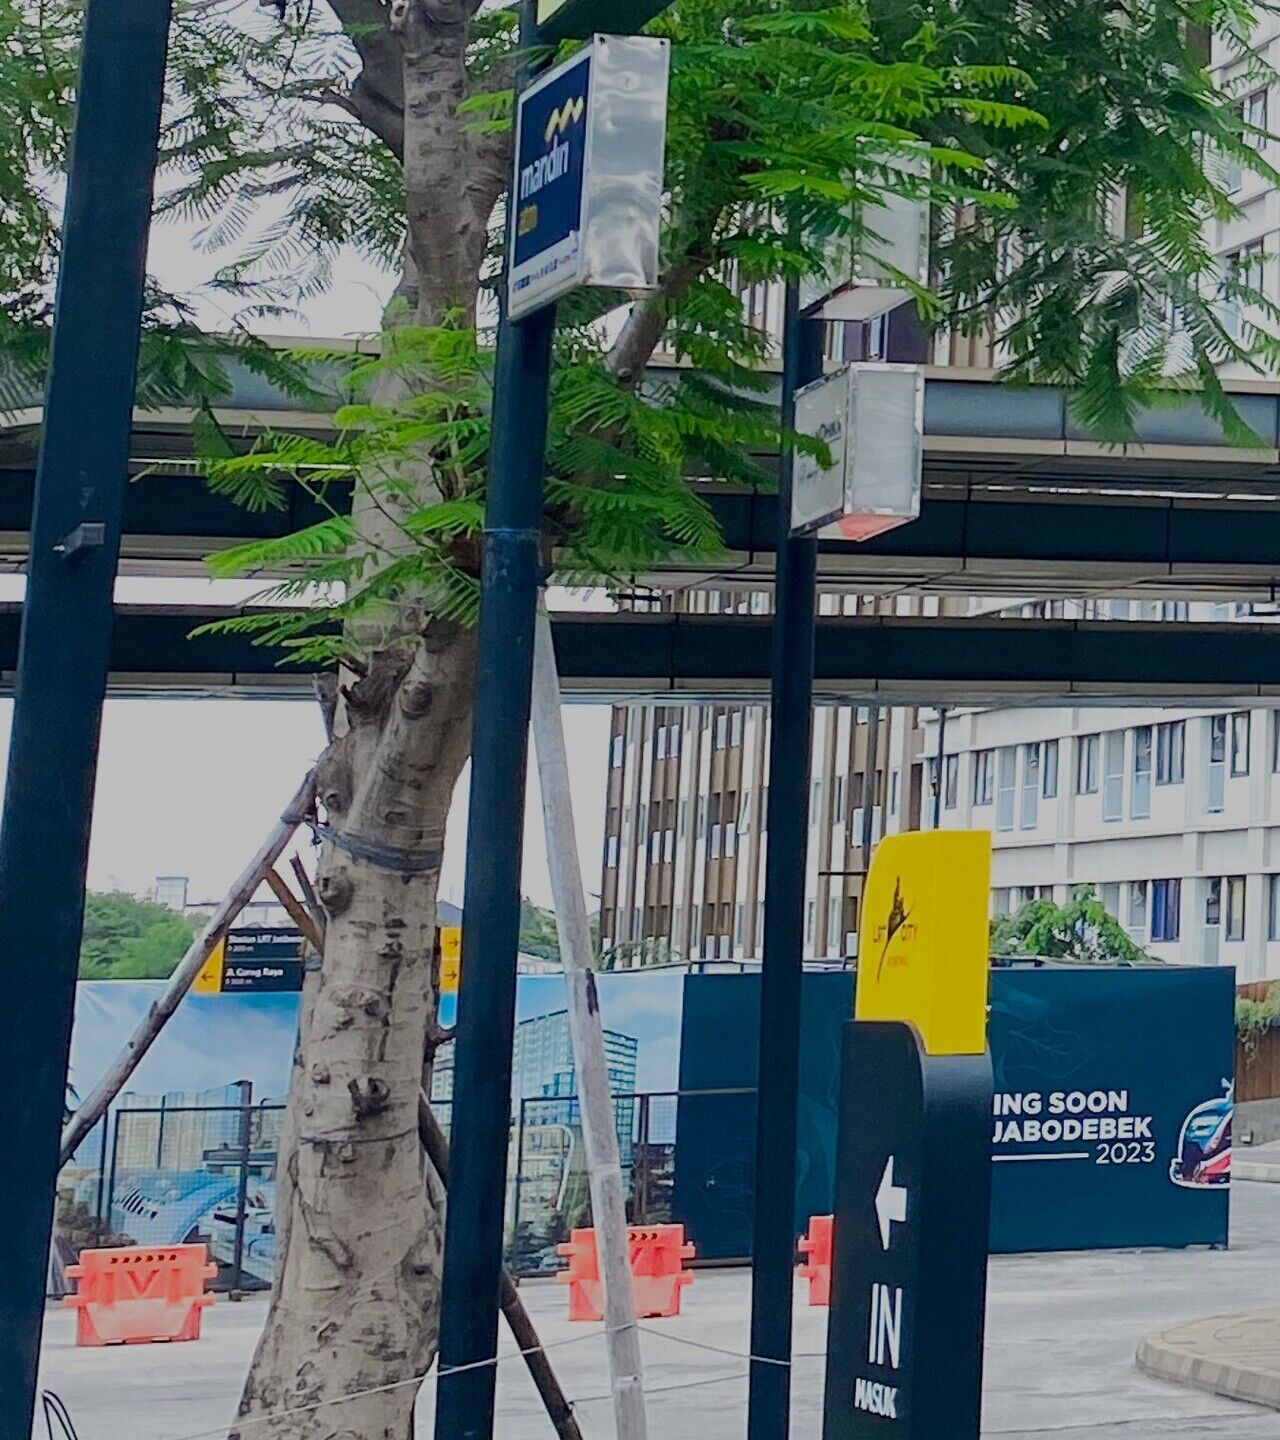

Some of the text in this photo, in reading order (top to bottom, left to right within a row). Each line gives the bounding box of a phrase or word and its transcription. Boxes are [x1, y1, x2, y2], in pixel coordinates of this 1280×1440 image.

[992, 1090, 1128, 1116] ING SOON
[991, 1116, 1153, 1144] JABODEBEK
[1095, 1141, 1156, 1165] 2023
[868, 1282, 903, 1370] IN
[854, 1377, 898, 1419] MASUK
